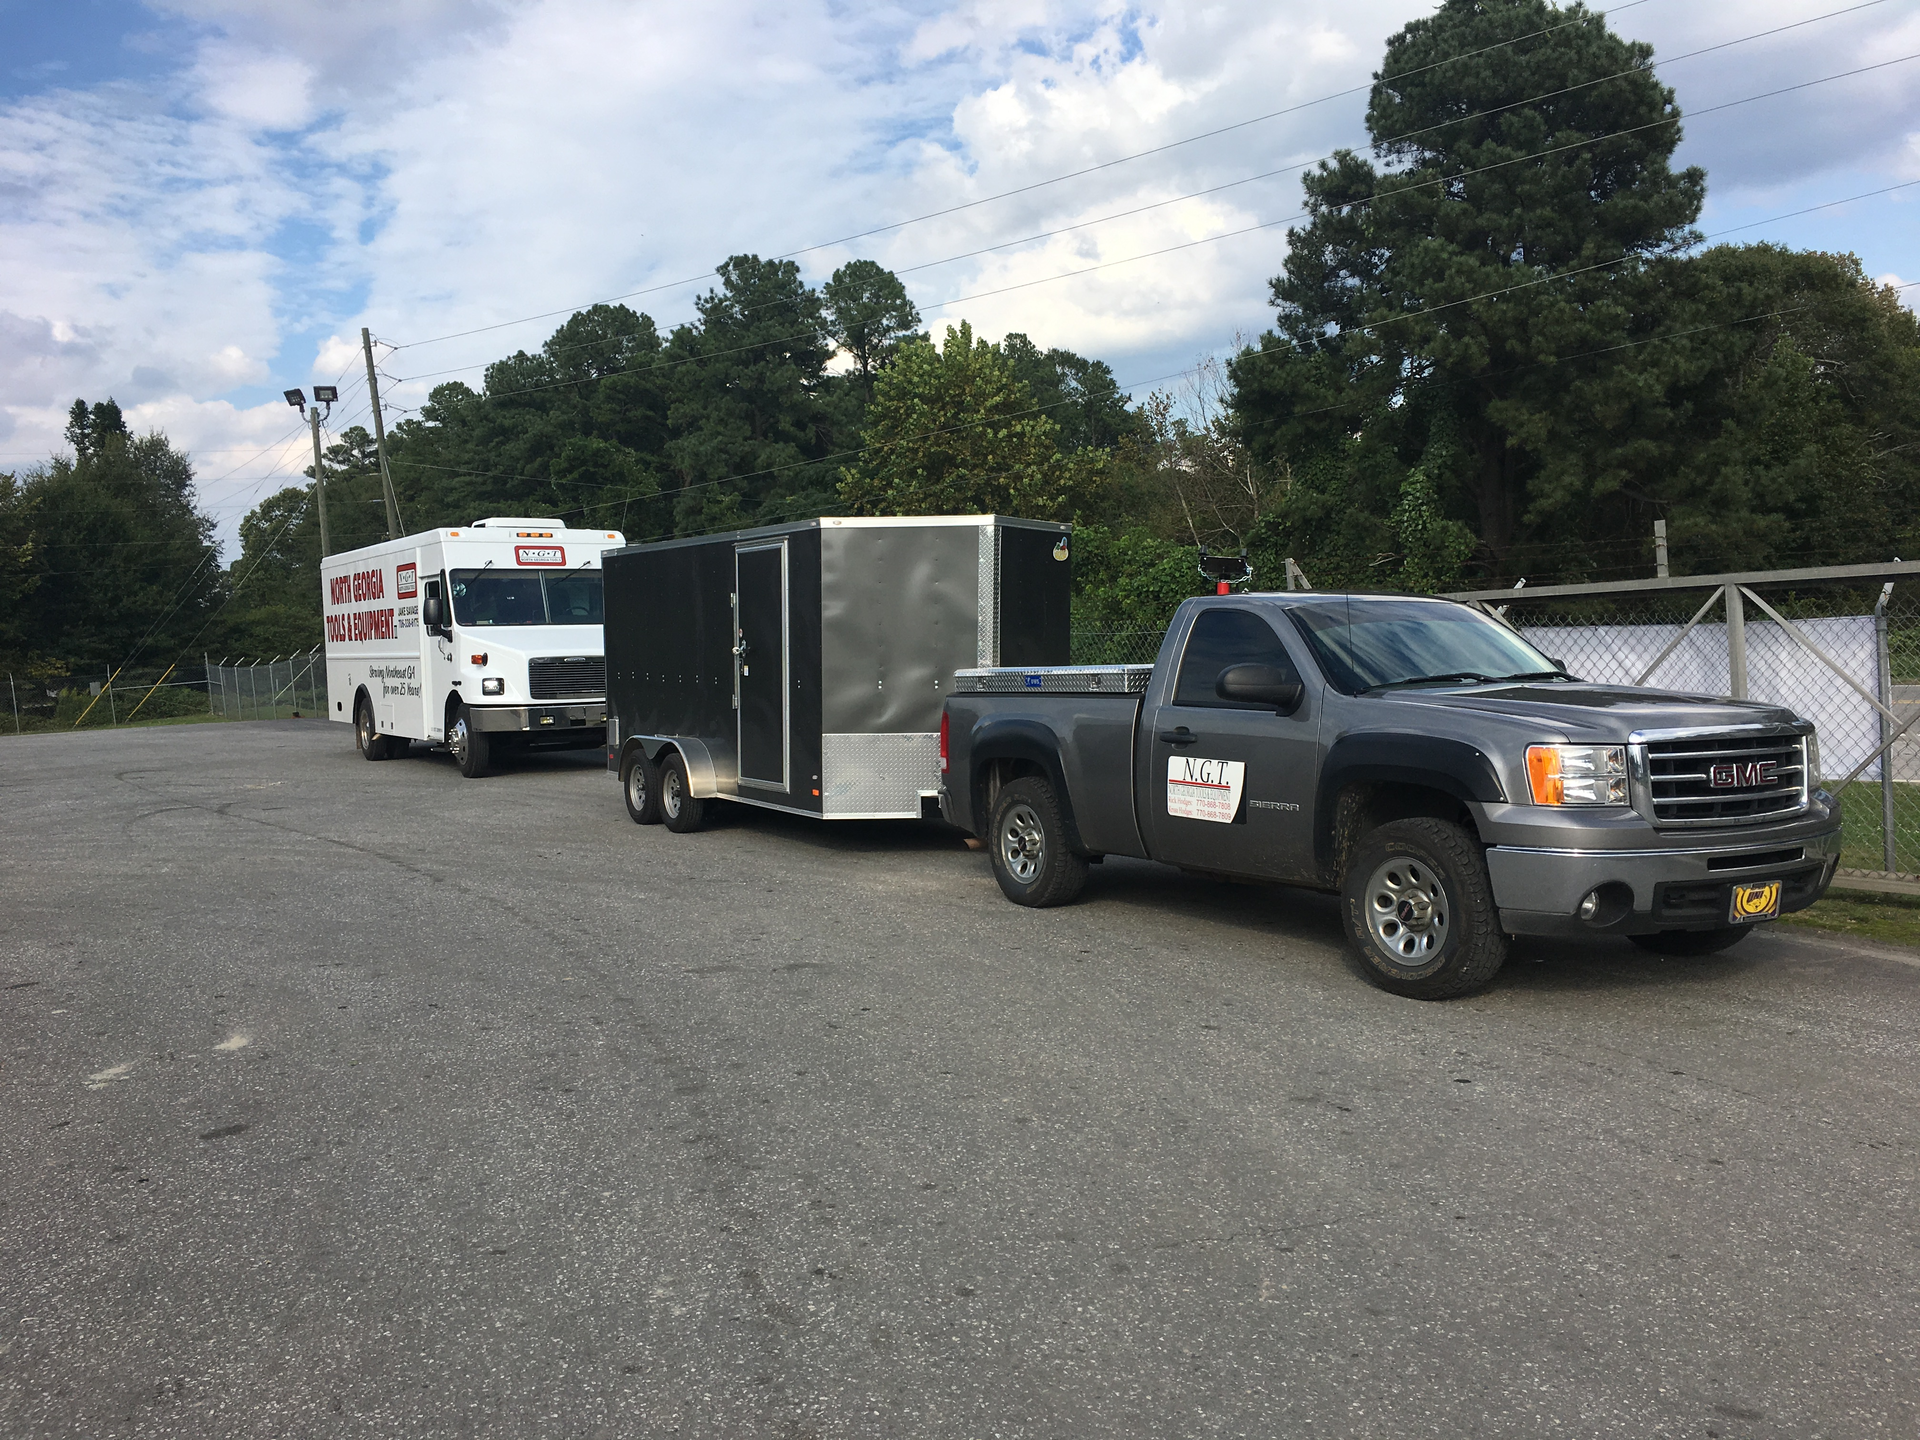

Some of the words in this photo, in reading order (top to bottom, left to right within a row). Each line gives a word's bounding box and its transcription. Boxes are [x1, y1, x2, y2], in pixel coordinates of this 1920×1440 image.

[330, 574, 352, 605] NORTH
[353, 568, 385, 602] GEORGIA
[326, 613, 346, 643] TOOLS
[347, 613, 353, 642] &
[353, 608, 394, 645] EQUIPMENT
[369, 665, 384, 683] Serving
[385, 665, 406, 679] Northeast
[407, 665, 415, 679] GA
[390, 685, 399, 695] over
[400, 682, 406, 696] 25
[1182, 757, 1230, 785] N.G.T.
[1711, 760, 1778, 788] GMC
[1250, 800, 1299, 812] SIERRA
